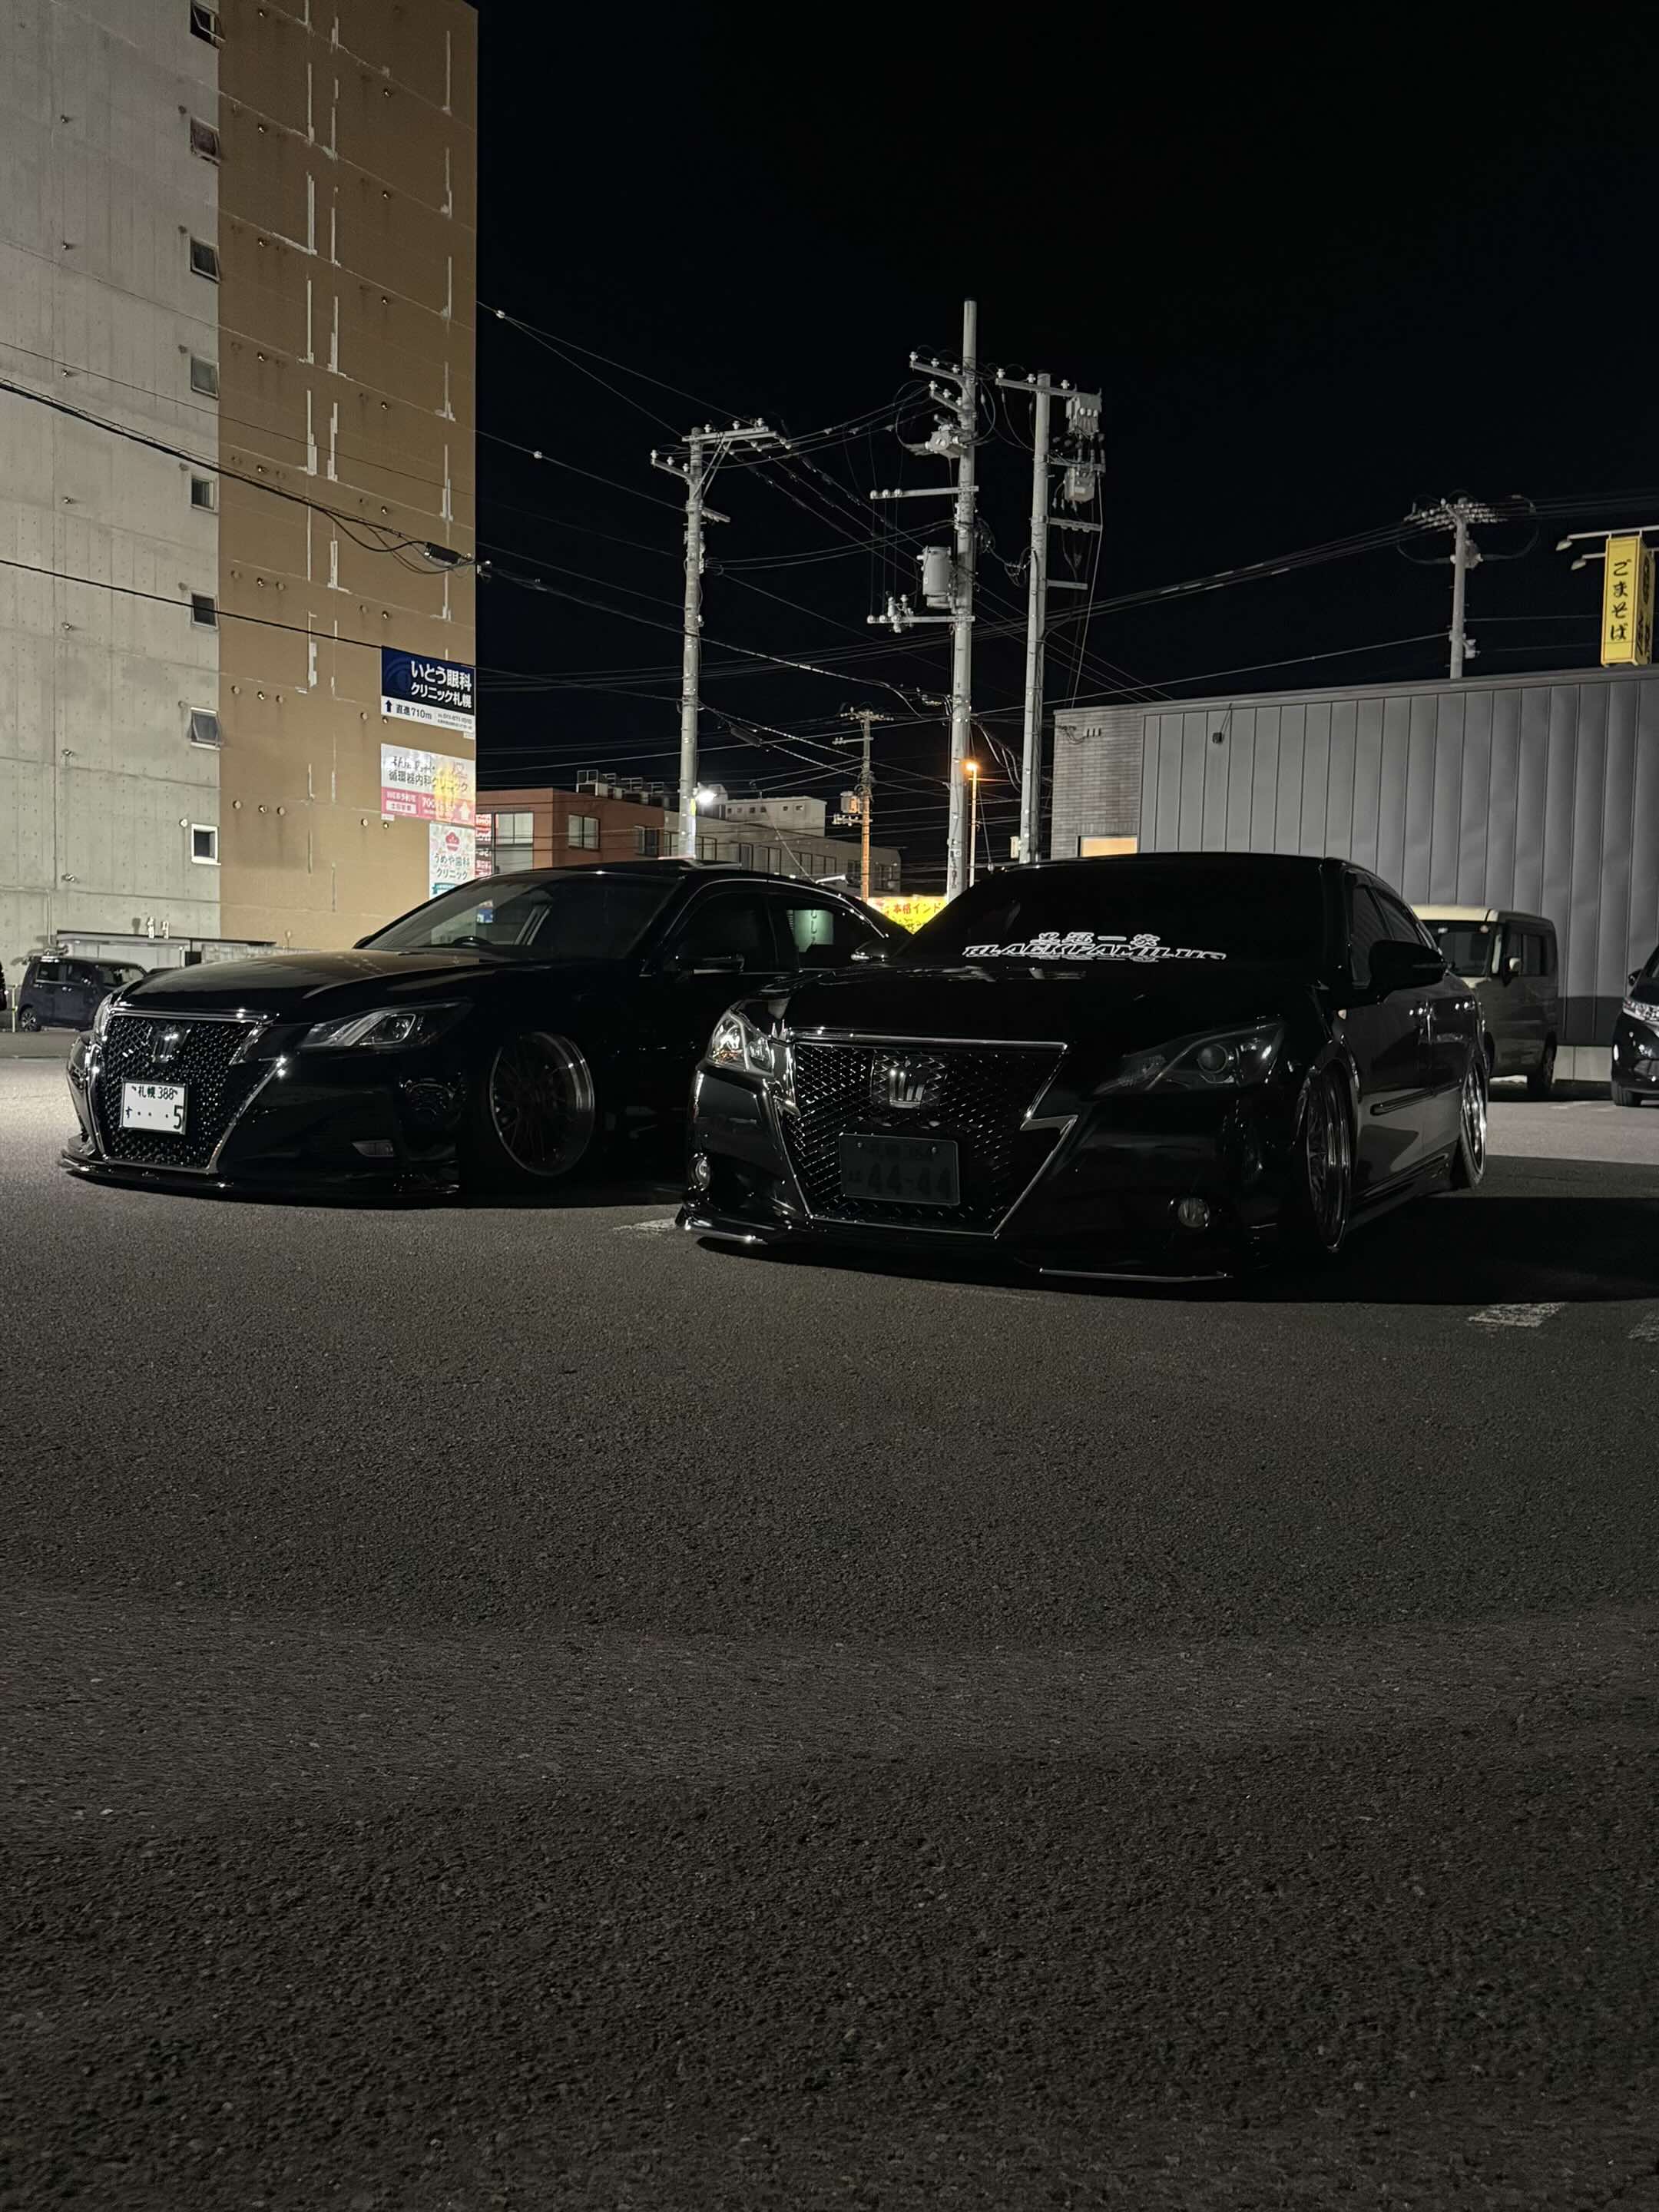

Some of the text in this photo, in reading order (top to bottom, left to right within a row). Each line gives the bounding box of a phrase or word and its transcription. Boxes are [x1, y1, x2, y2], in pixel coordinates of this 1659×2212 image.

[1610, 558, 1631, 641] ごまそば
[411, 661, 472, 691] いとう眼科
[411, 682, 472, 708] クリニック札幌
[436, 867, 468, 880] クリニック
[157, 1087, 174, 1100] 388
